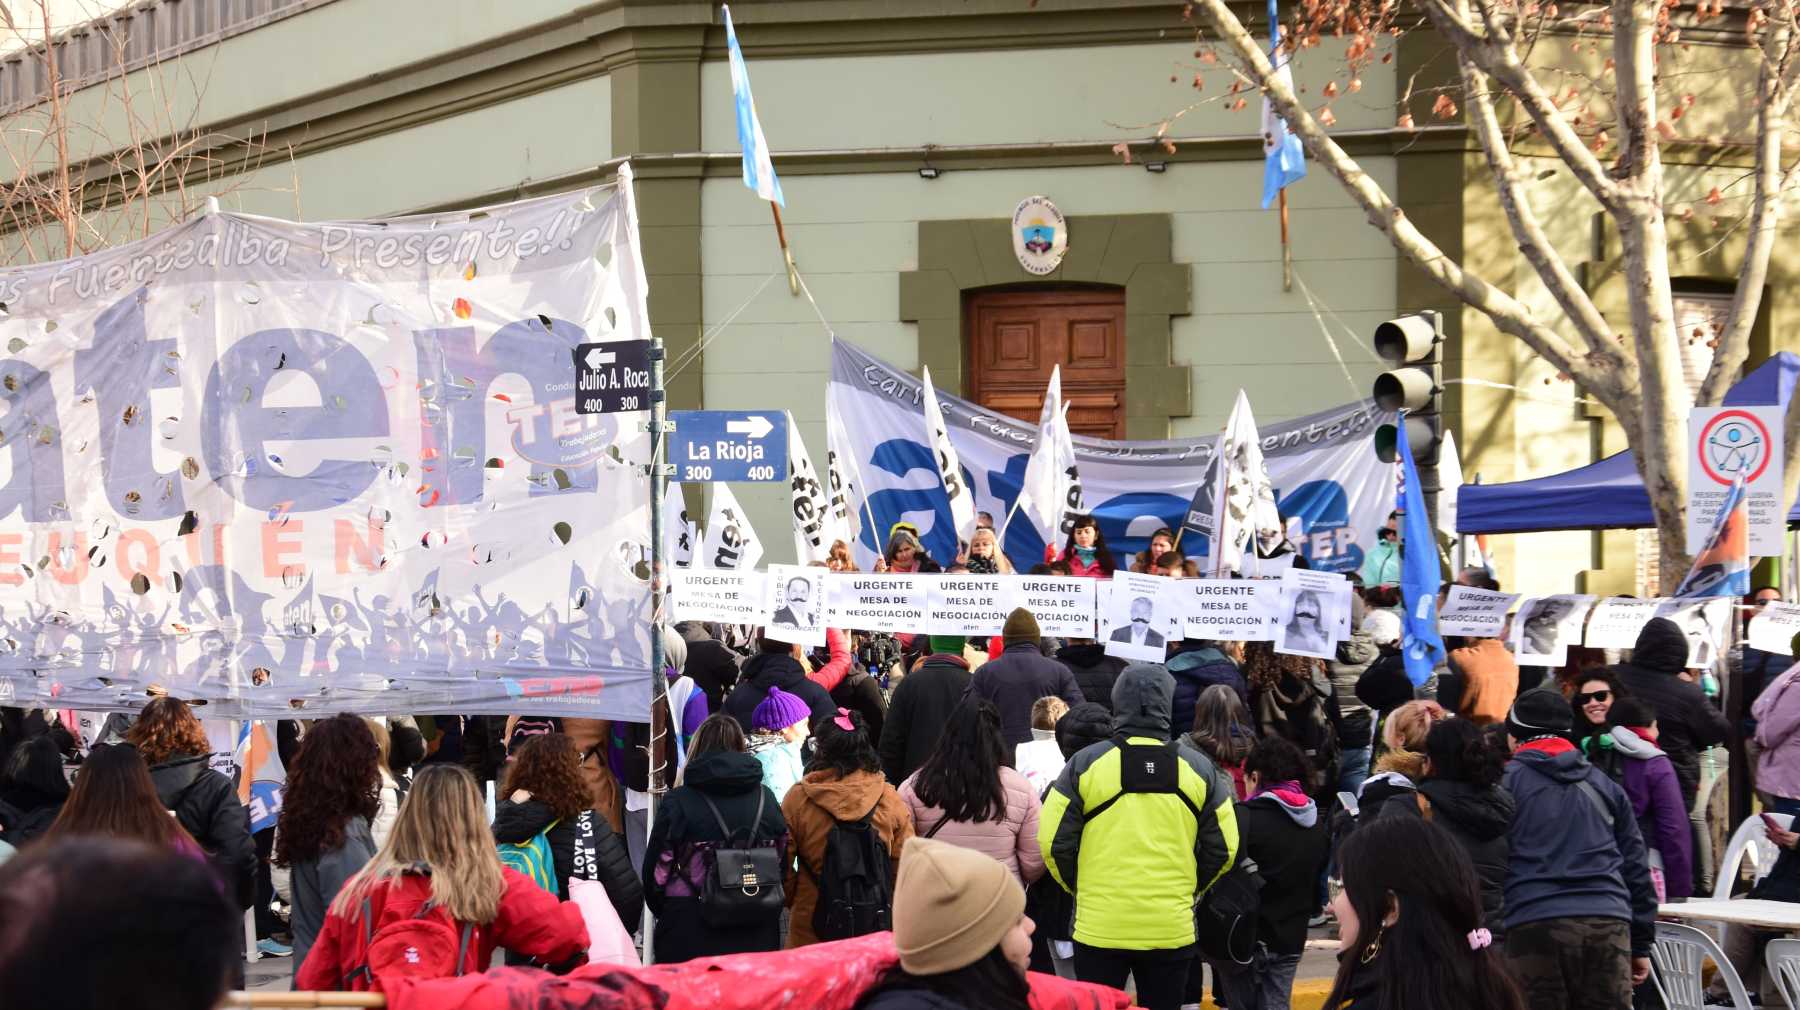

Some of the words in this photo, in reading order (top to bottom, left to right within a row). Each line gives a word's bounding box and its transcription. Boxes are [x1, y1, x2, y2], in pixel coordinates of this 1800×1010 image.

[47, 218, 291, 304] Fuentealba
[579, 370, 607, 391] Julio
[609, 367, 621, 388] A.
[623, 367, 649, 388] Roca
[583, 398, 603, 412] 400
[620, 396, 638, 410] 300
[688, 441, 711, 461] La
[716, 441, 764, 463] Rioja
[685, 465, 712, 481] 300
[747, 465, 774, 481] 400
[685, 576, 744, 585] URGENTE
[854, 581, 913, 590] URGENTE
[940, 582, 999, 591] URGENTE
[1023, 582, 1082, 592] URGENTE
[1195, 586, 1254, 595] URGENTE
[725, 592, 739, 600] DE
[860, 596, 890, 604] MESA
[946, 597, 976, 605] MESA
[980, 598, 993, 606] DE
[1028, 598, 1058, 607] MESA
[1062, 600, 1075, 608] DE
[1201, 602, 1231, 610] MESA
[1234, 602, 1248, 610] DE
[581, 810, 594, 838] LOVE
[574, 839, 585, 874] LOVE
[584, 848, 598, 880] LOVE
